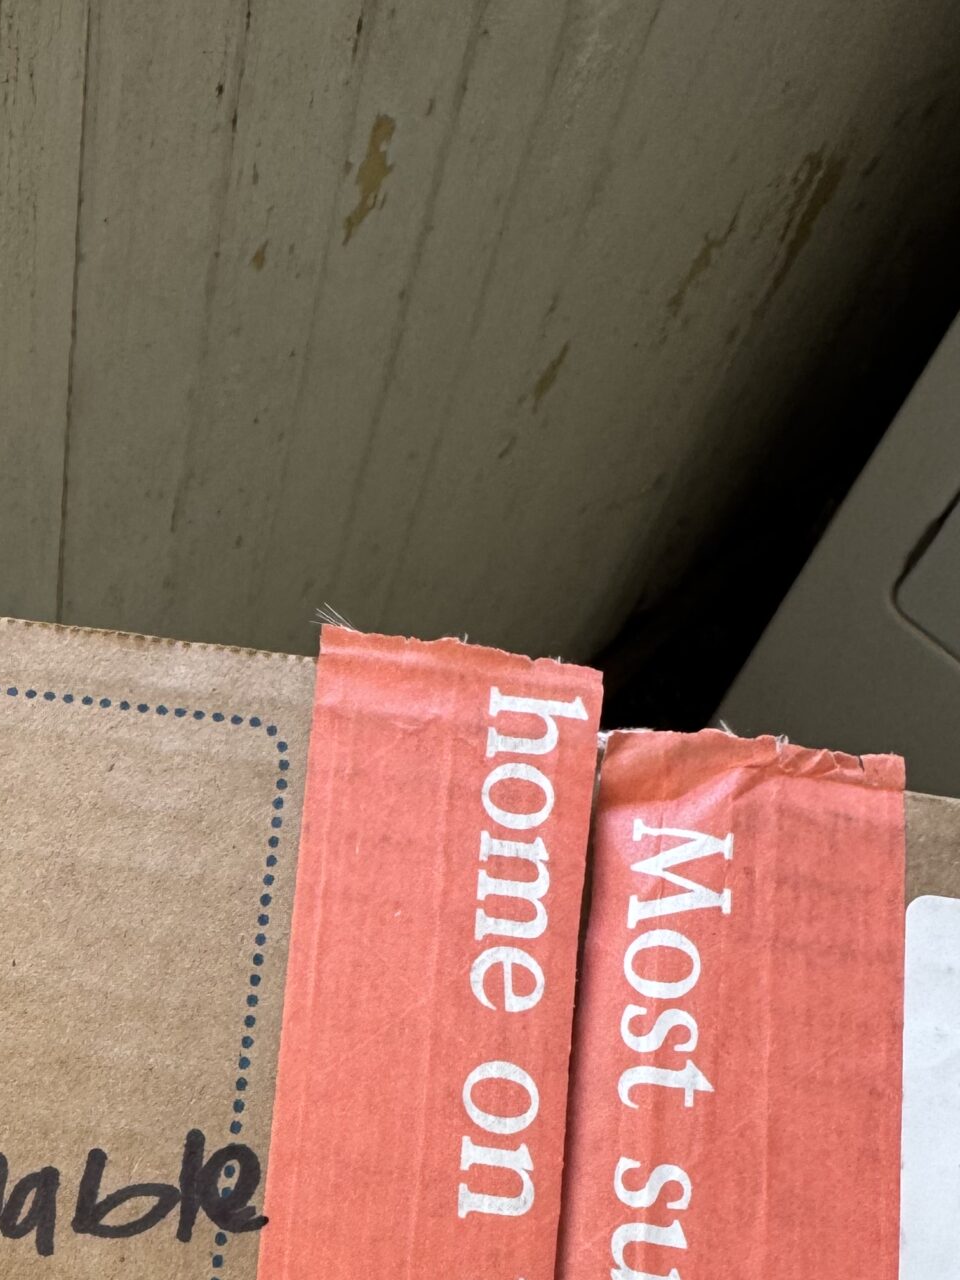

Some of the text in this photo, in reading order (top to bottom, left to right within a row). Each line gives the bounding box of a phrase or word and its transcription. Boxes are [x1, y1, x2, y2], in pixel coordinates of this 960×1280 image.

[469, 686, 589, 1014] home
[616, 818, 734, 1109] Most
[457, 1060, 539, 1220] on
